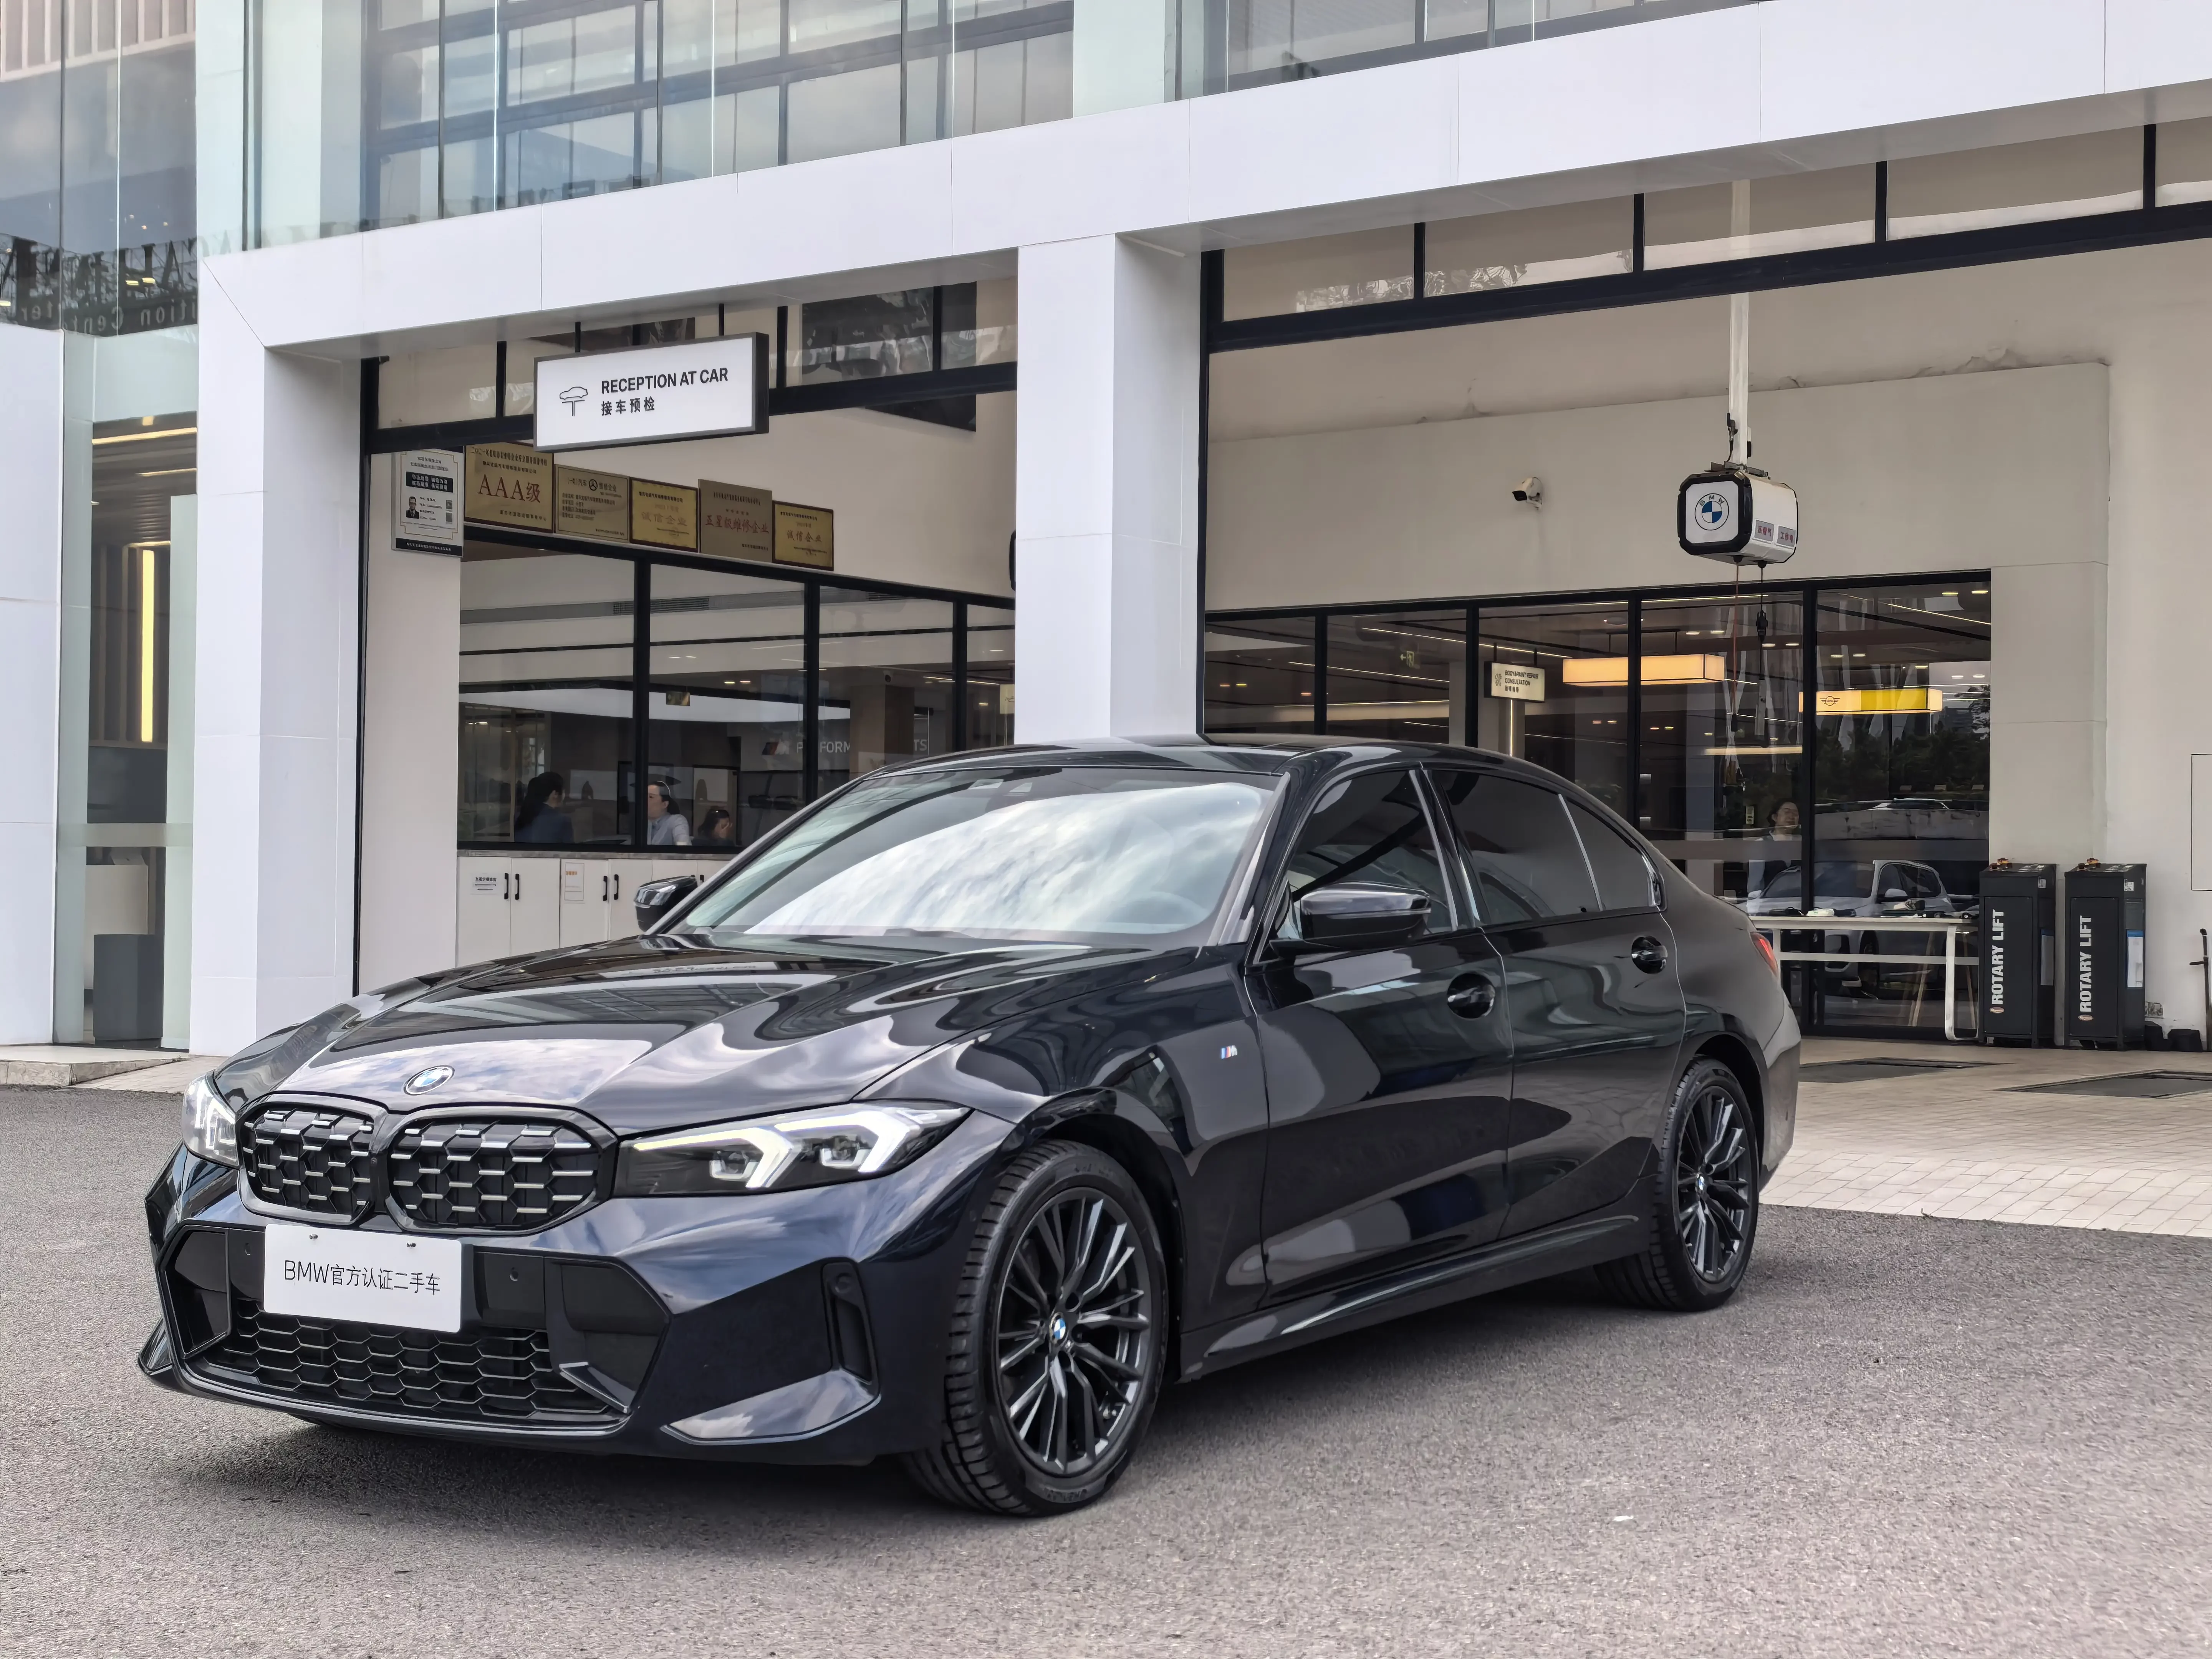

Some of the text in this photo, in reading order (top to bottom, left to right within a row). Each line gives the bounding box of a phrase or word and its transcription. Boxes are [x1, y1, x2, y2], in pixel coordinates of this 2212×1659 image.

[602, 368, 729, 394] RECEPTION AT CAR
[601, 396, 655, 416] 接车预检
[1992, 909, 2004, 1005] ROTARY LIFT
[2080, 915, 2091, 1012] ROTARY LIFT
[284, 1260, 441, 1296] BMW官方认证二手车
